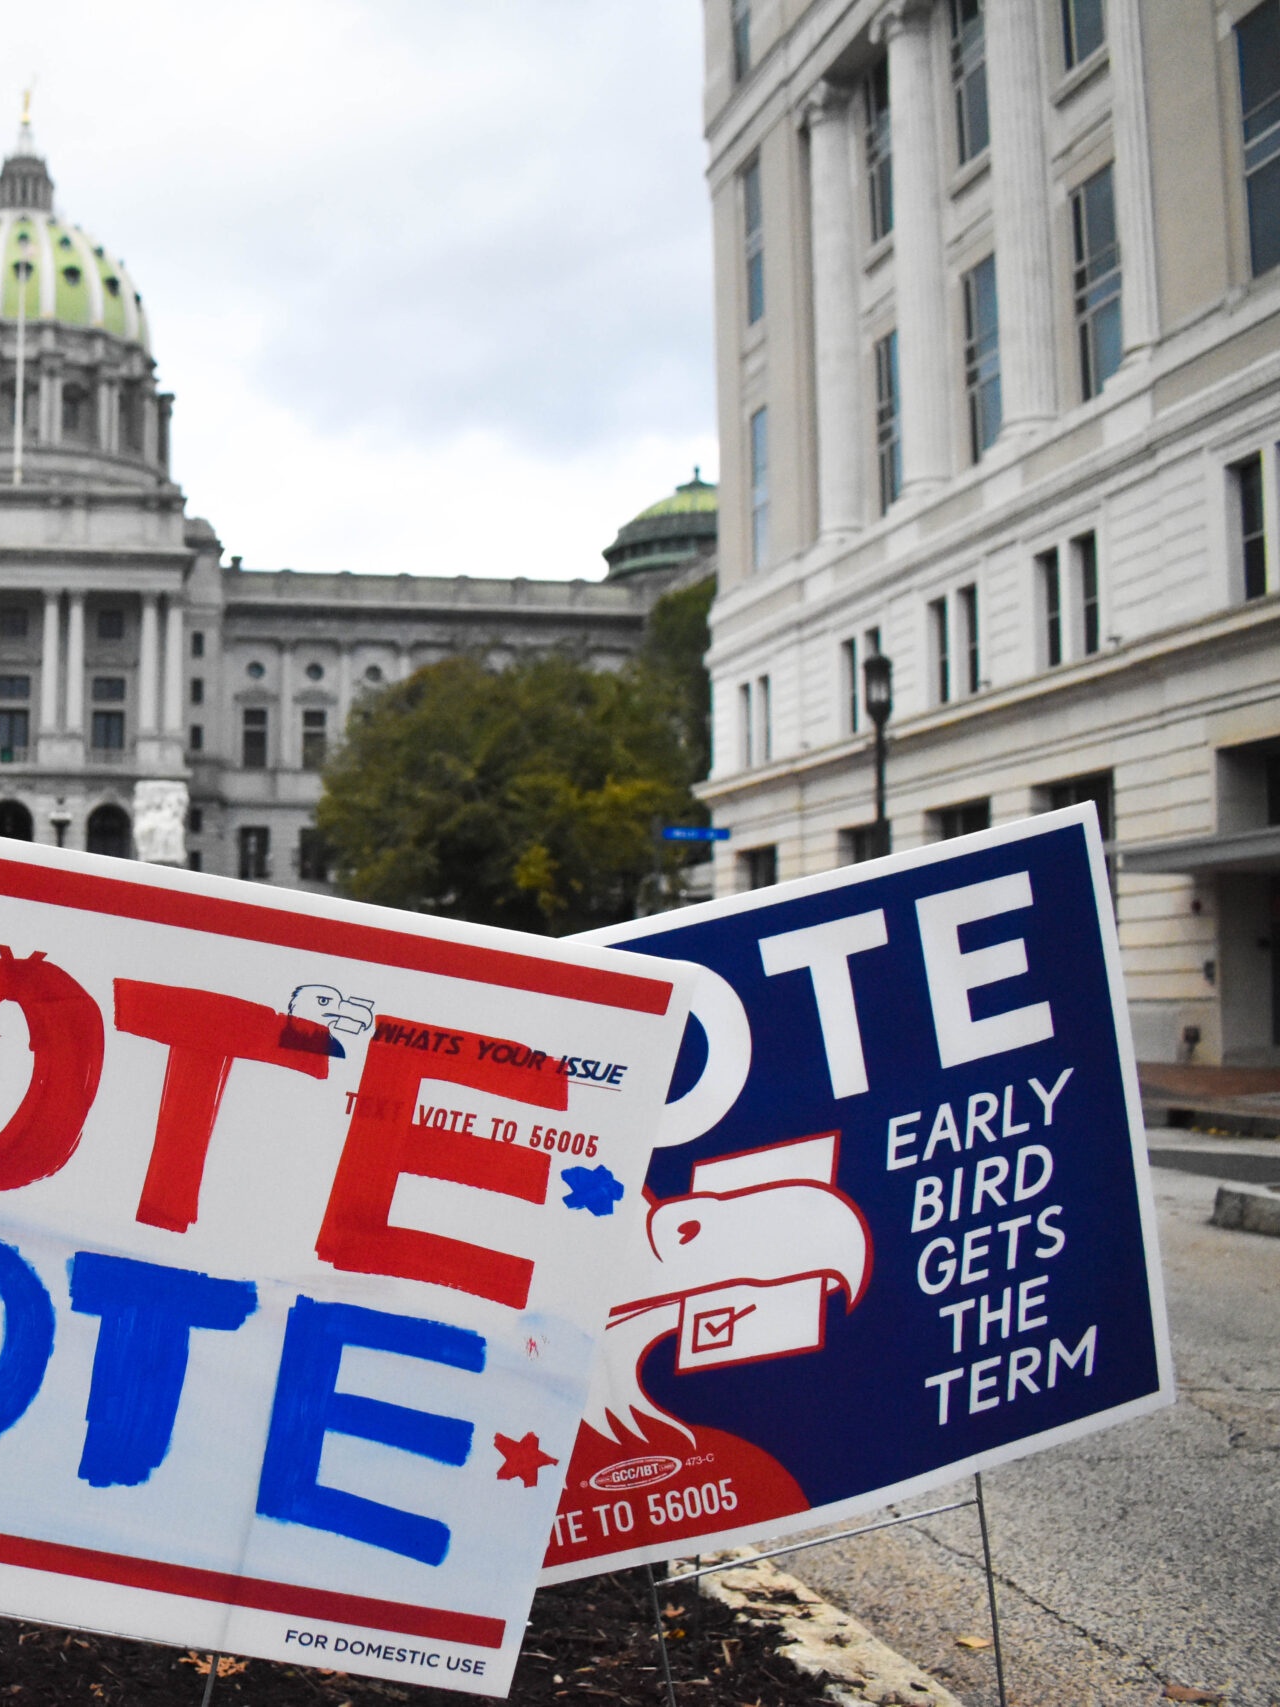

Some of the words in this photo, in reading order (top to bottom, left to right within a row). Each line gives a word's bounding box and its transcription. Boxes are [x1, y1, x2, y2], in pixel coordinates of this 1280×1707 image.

[654, 870, 1055, 1148] OTE
[372, 1021, 464, 1056] WHATS
[478, 1040, 548, 1071] YOUR
[555, 1054, 627, 1085] ISSUE
[420, 1104, 477, 1136] VOTE
[491, 1117, 518, 1144] TO
[529, 1125, 599, 1158] 56005
[887, 1067, 1074, 1172] EARLY
[911, 1144, 1054, 1233] BIRD
[917, 1205, 1067, 1296] GETS
[939, 1276, 1050, 1354] THE
[925, 1325, 1097, 1426] TERM
[611, 1463, 659, 1483] GCC/IBT
[685, 1453, 715, 1467] 473-C
[553, 1510, 588, 1547] TE
[592, 1501, 634, 1537] TO
[647, 1478, 738, 1526] 56005
[285, 1629, 328, 1650] FOR
[333, 1637, 440, 1668] DOMESTIC
[446, 1655, 487, 1676] USE
